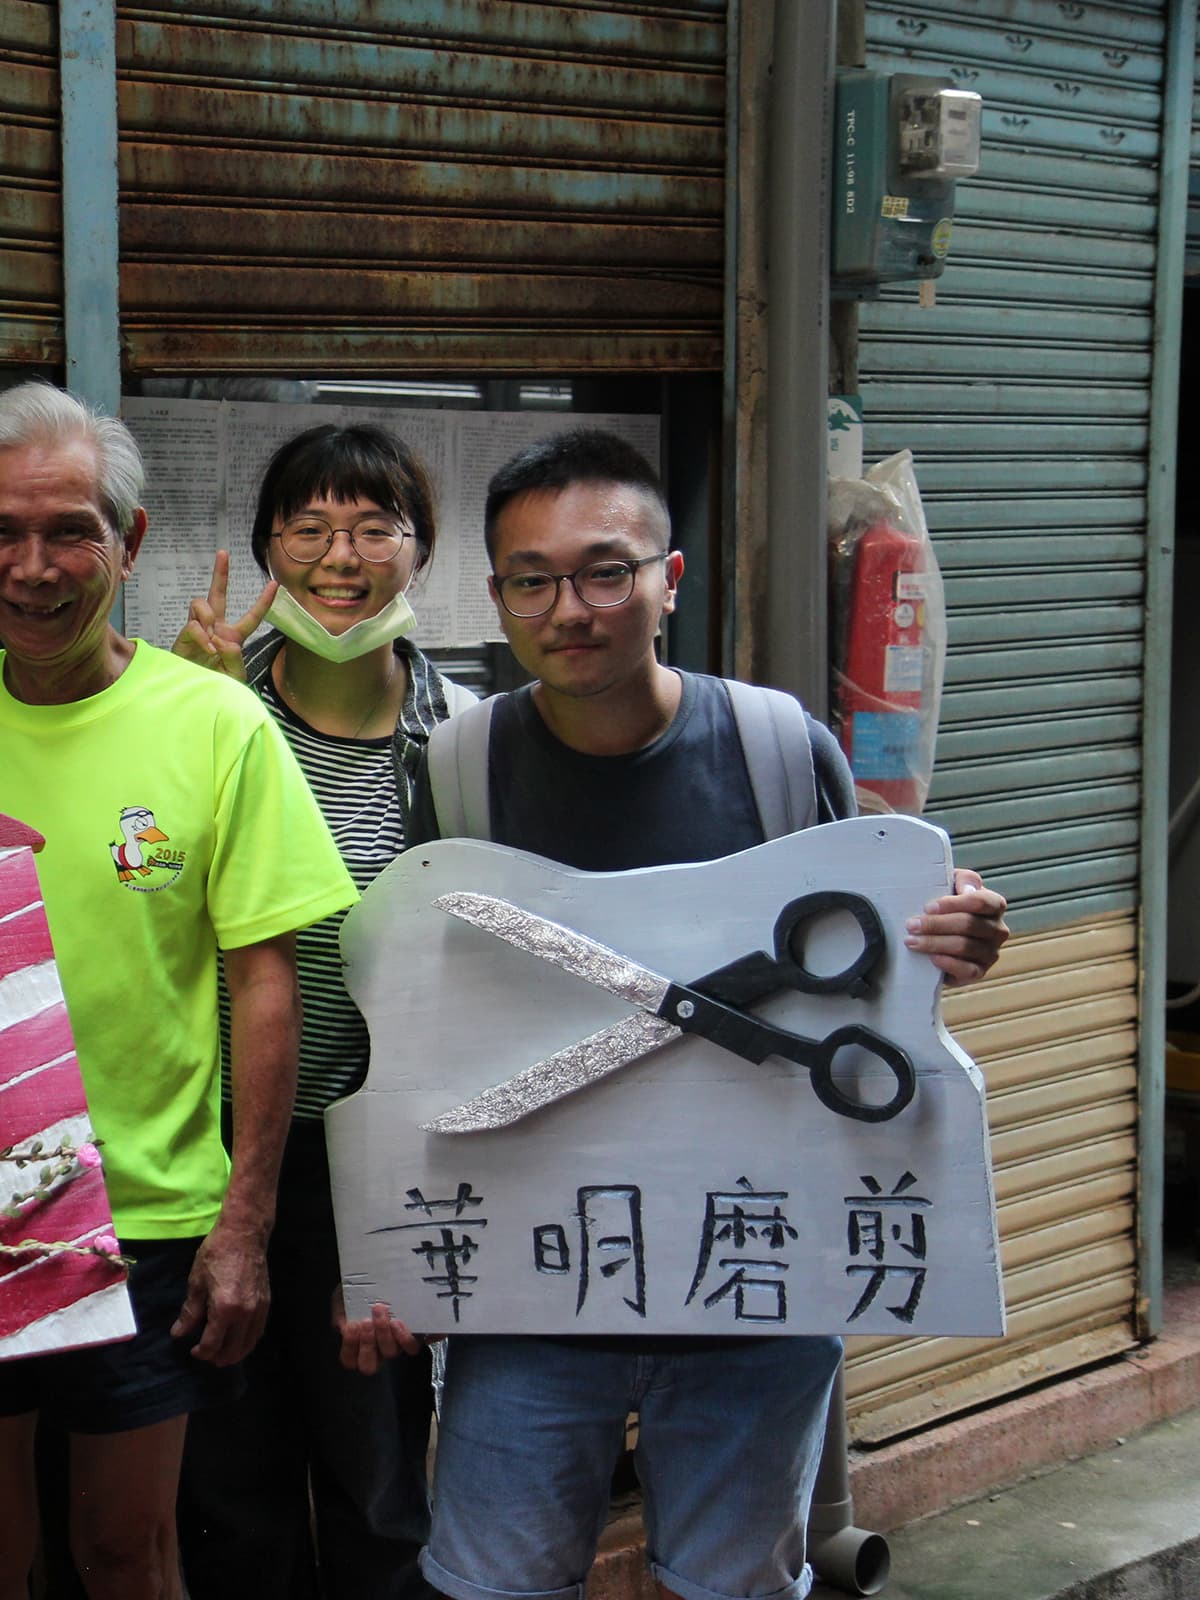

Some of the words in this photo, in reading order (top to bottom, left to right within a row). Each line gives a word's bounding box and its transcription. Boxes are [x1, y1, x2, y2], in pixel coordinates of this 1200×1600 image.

[154, 847, 186, 862] 2015
[366, 1171, 933, 1324] 華明磨剪
